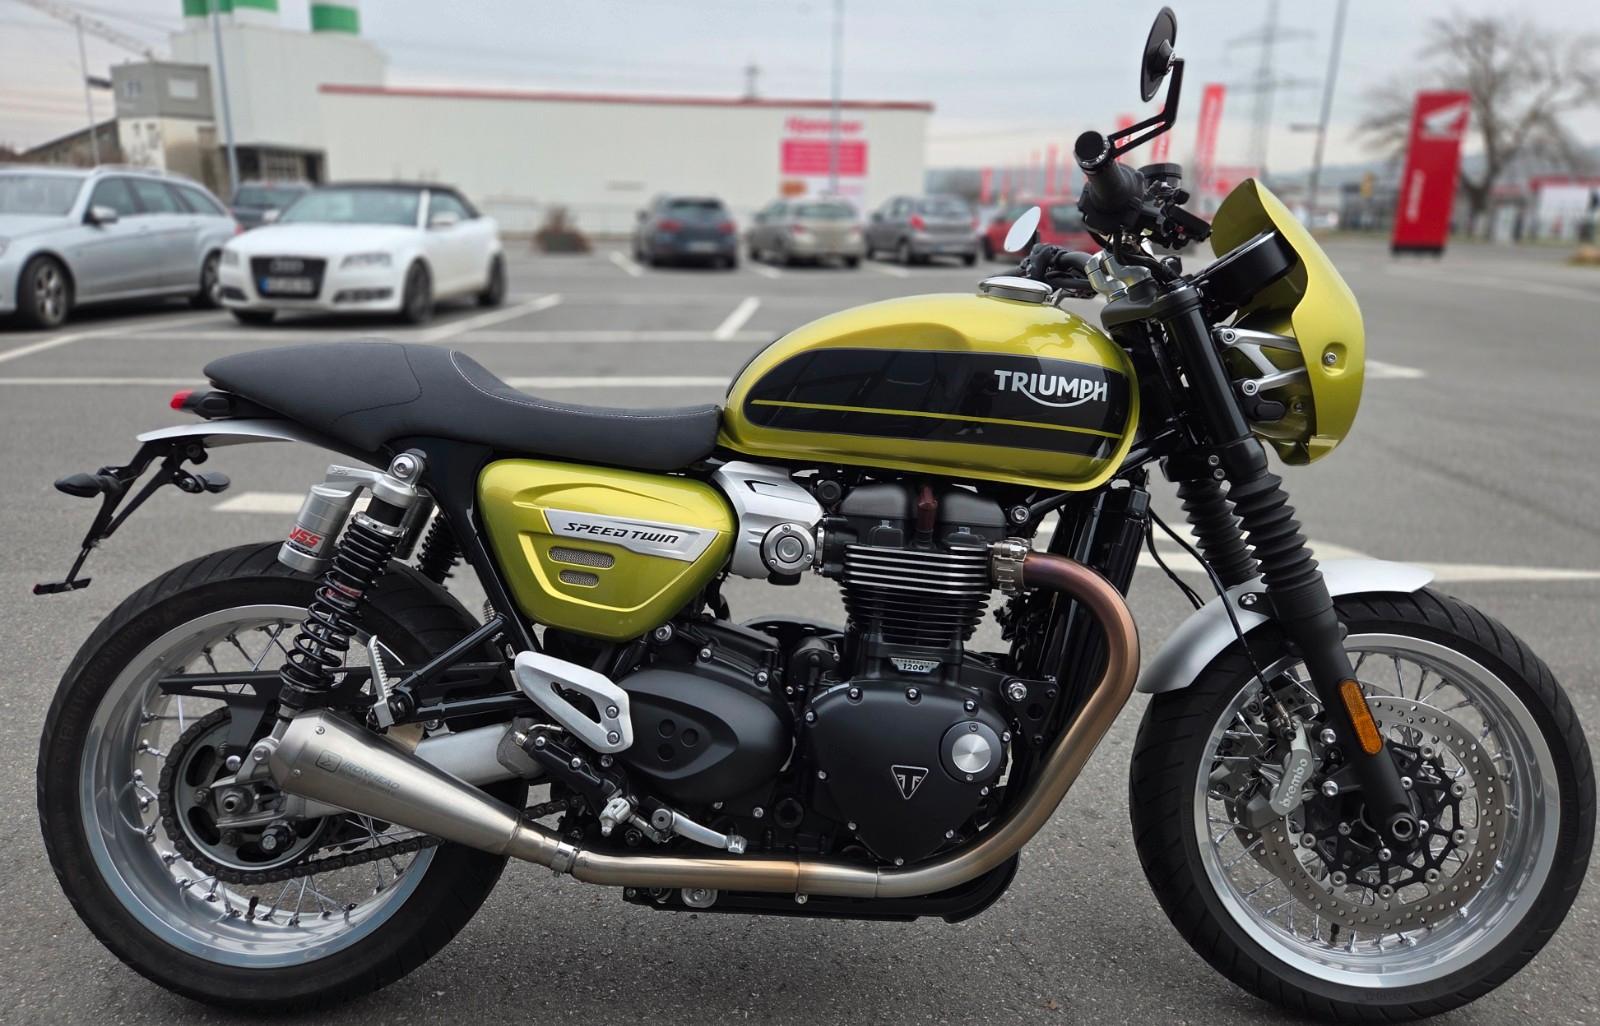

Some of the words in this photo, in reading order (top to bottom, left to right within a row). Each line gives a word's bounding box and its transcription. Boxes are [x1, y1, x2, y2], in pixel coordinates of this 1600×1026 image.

[993, 369, 1108, 408] TRIUMPH
[563, 522, 629, 538] SPEED
[630, 530, 680, 545] TWIN
[1279, 758, 1308, 808] brembo
